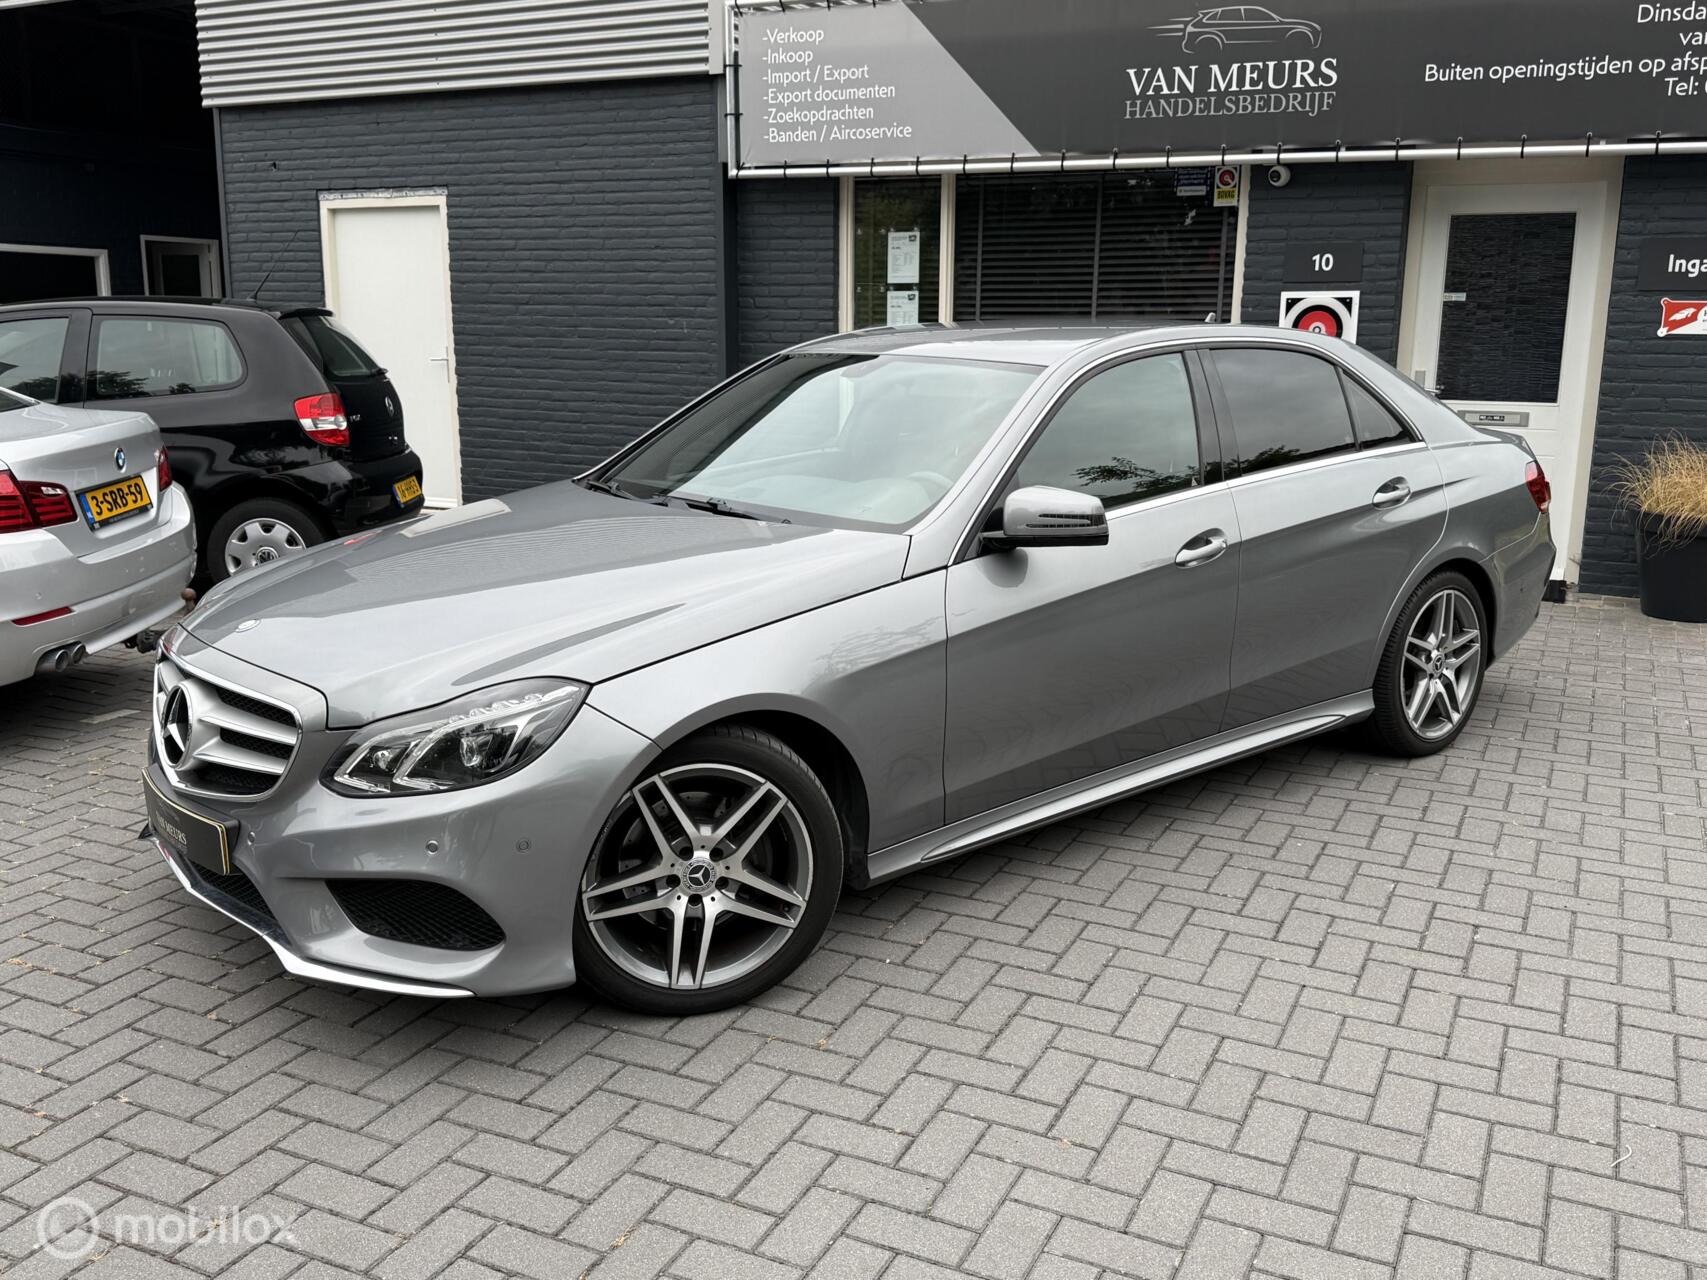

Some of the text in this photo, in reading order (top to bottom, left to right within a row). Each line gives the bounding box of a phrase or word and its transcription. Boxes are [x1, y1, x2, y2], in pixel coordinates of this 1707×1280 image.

[1637, 0, 1707, 23] Dinsda
[762, 27, 824, 44] -Verkoop
[762, 48, 813, 65] -Inkoop
[762, 64, 869, 86] -Import / Export
[1126, 57, 1338, 96] VAN MEURS
[1425, 63, 1484, 82] Buiten
[1489, 55, 1633, 84] openingstijden
[1639, 58, 1666, 77] op
[763, 83, 895, 106] -Export documenten
[1664, 75, 1699, 96] Tel:
[763, 105, 874, 125] -Zoekopdrachten
[1124, 91, 1336, 119] HANDELSBEDRIJF
[763, 122, 912, 143] -Banden / Aircoservice
[1312, 253, 1334, 272] 10
[91, 482, 144, 516] 3-SRB-59
